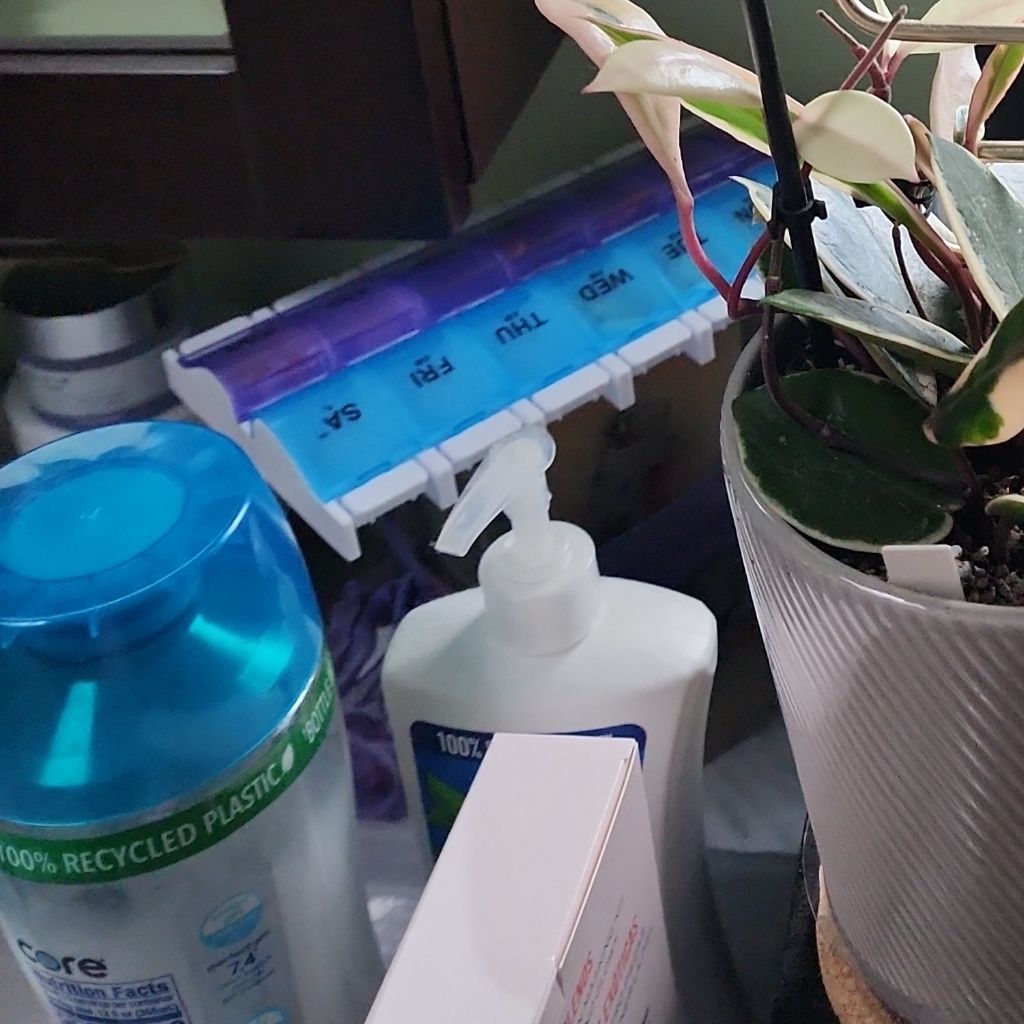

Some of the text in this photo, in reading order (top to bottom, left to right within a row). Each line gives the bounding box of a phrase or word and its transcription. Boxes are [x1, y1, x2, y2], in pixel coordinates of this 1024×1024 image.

[579, 268, 634, 302] WED
[495, 312, 550, 345] THU
[410, 356, 454, 389] FRI
[318, 402, 362, 439] SA
[436, 731, 484, 759] 100%
[62, 822, 197, 874] RECYCLED
[202, 762, 281, 834] PLASTIC
[112, 982, 171, 999] Facts
